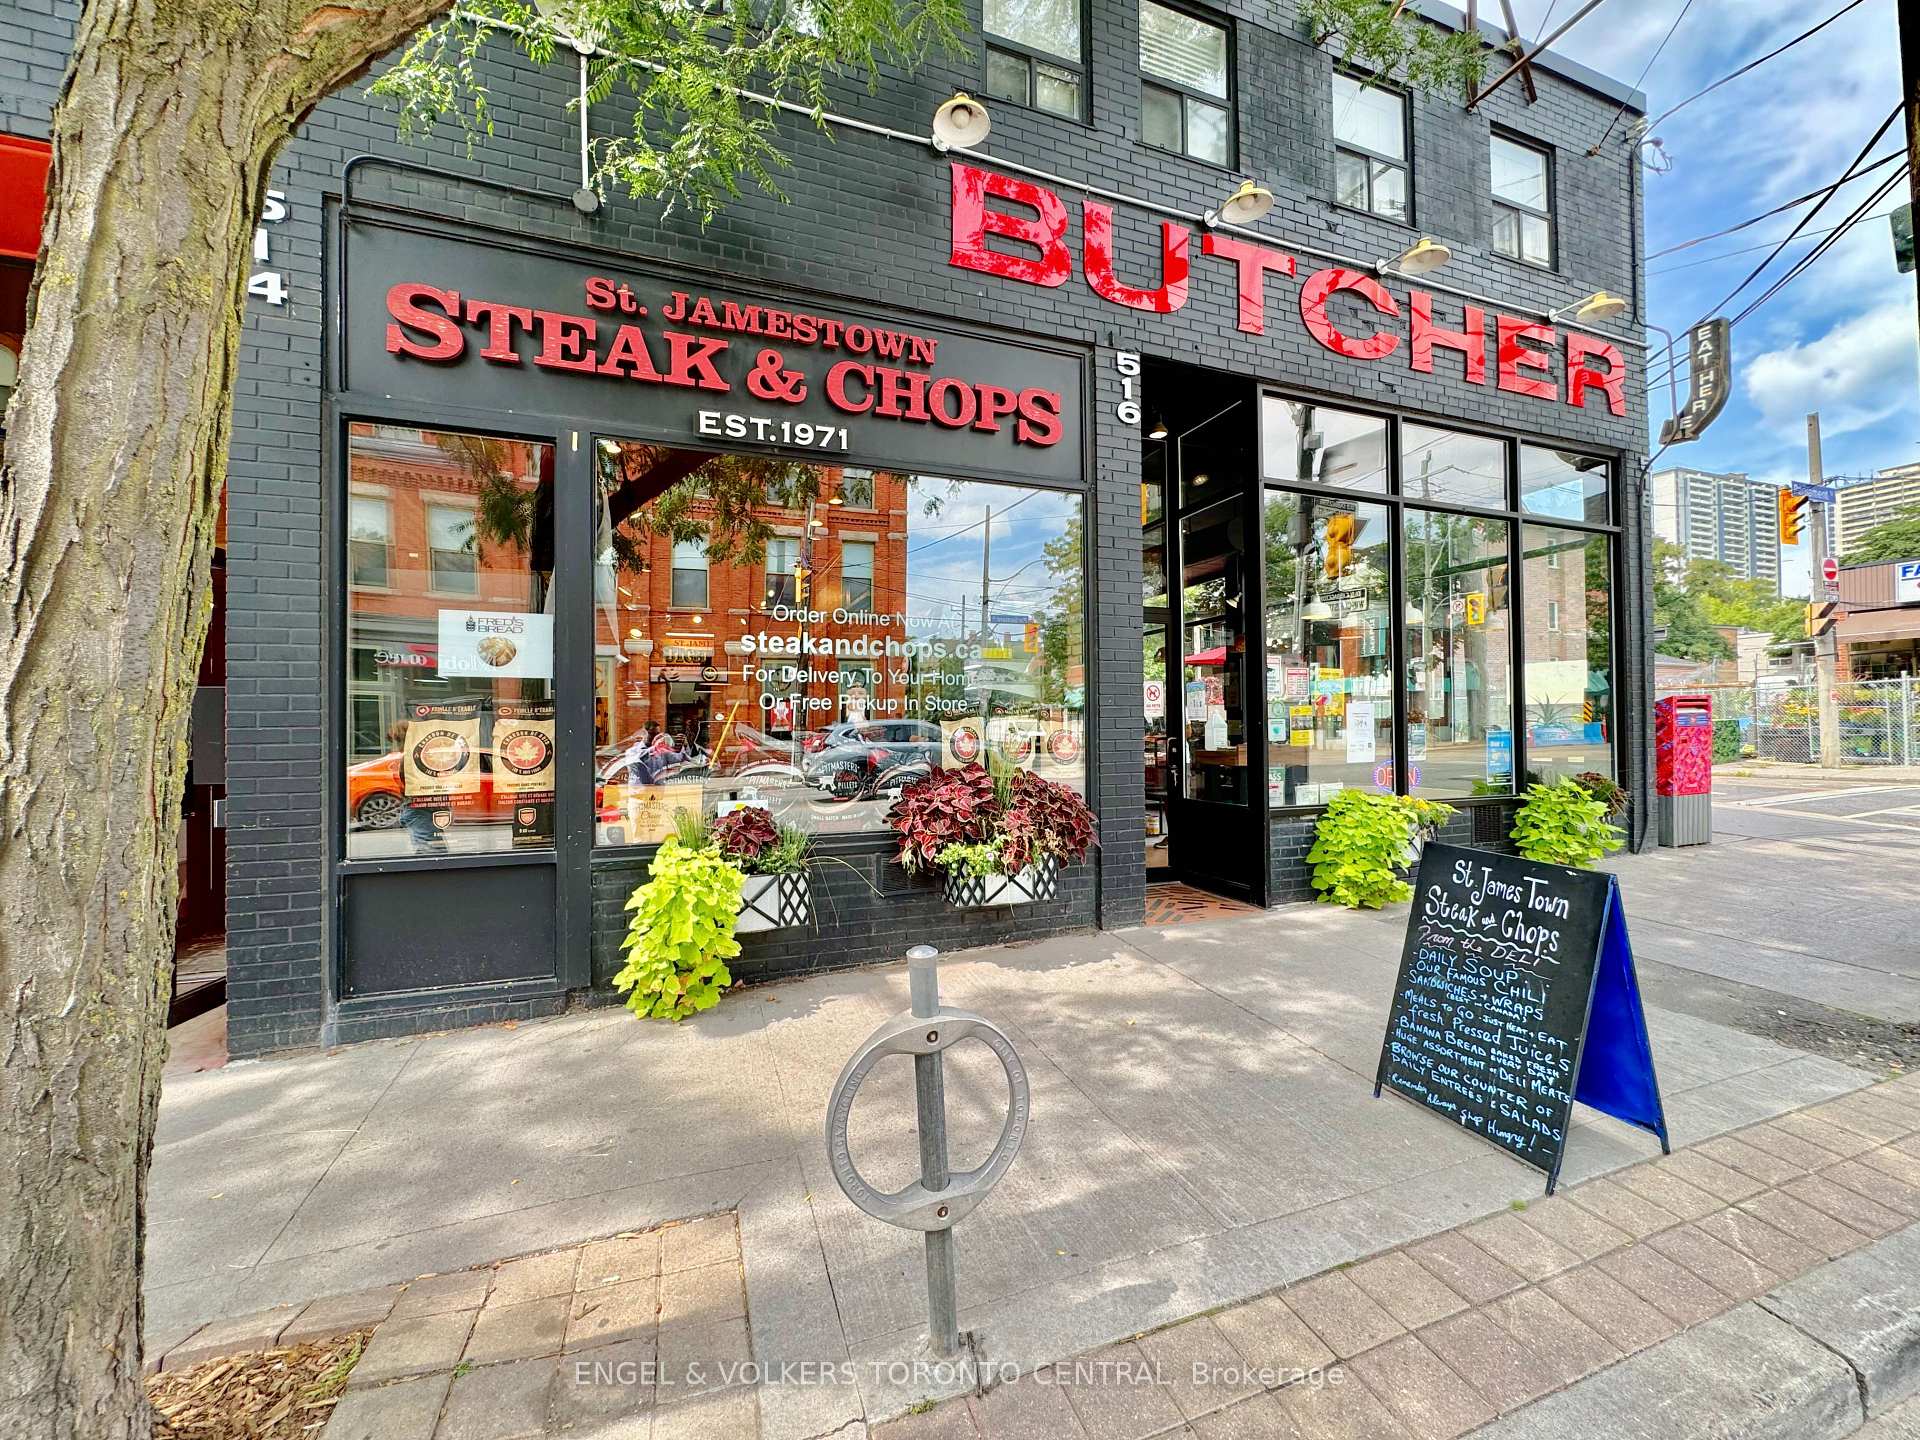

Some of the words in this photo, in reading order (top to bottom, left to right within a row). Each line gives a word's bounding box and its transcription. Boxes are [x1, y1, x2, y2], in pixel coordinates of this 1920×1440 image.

[950, 161, 1626, 416] BUTCHER
[584, 276, 649, 316] St.
[662, 291, 938, 365] JAMESTOWN
[385, 282, 731, 393] STEAK
[746, 348, 808, 404] &
[826, 360, 1063, 447] CHOPS
[698, 410, 850, 451] EST.1971
[477, 616, 525, 626] FRED'S
[477, 625, 524, 634] BREAD
[773, 605, 827, 624] Order
[832, 608, 890, 626] Online
[896, 611, 934, 627] Now
[937, 612, 958, 628] At
[740, 631, 983, 664] steakandchops.ca
[743, 665, 774, 682] For
[782, 666, 857, 689] Delivery
[864, 668, 883, 685] To
[888, 669, 925, 686] Your
[759, 693, 783, 711] Or
[790, 694, 832, 711] Free
[838, 695, 898, 714] Pickup
[904, 696, 919, 712] In
[925, 696, 969, 712] Store
[1376, 767, 1417, 787] OPN
[1470, 867, 1524, 906] James
[1523, 876, 1570, 920] Town
[1425, 885, 1480, 928] Steak
[1501, 909, 1560, 956] Chops
[1419, 948, 1458, 968] DAILY
[1462, 958, 1518, 984] SOUP
[1460, 938, 1483, 953] the
[1490, 945, 1541, 967] DELI
[1408, 969, 1478, 1000] SANDWICHES
[1491, 995, 1544, 1021] WRAPS
[1416, 960, 1442, 976] OUR
[1446, 967, 1487, 987] FAMOUS
[1493, 980, 1549, 1005] CHILI
[1400, 1015, 1442, 1041] BANANA
[1444, 1031, 1487, 1057] BREAD
[1404, 988, 1438, 1008] MEALS
[1440, 1003, 1453, 1012] TO
[1456, 1005, 1474, 1020] GO
[1537, 1031, 1569, 1052] EAT
[1408, 1004, 1444, 1026] fresh
[1452, 1016, 1502, 1045] Pressed
[1391, 1041, 1435, 1069] BROWSE
[1437, 1063, 1460, 1079] OUR
[1463, 1074, 1529, 1110] COUNTER
[1535, 1105, 1555, 1118] OF
[1395, 1029, 1419, 1045] HUGE
[1423, 1040, 1487, 1071] ASSORTMENT
[1531, 1080, 1571, 1105] MEATS
[1391, 1052, 1426, 1076] DAILY
[1499, 1103, 1561, 1141] SALADS
